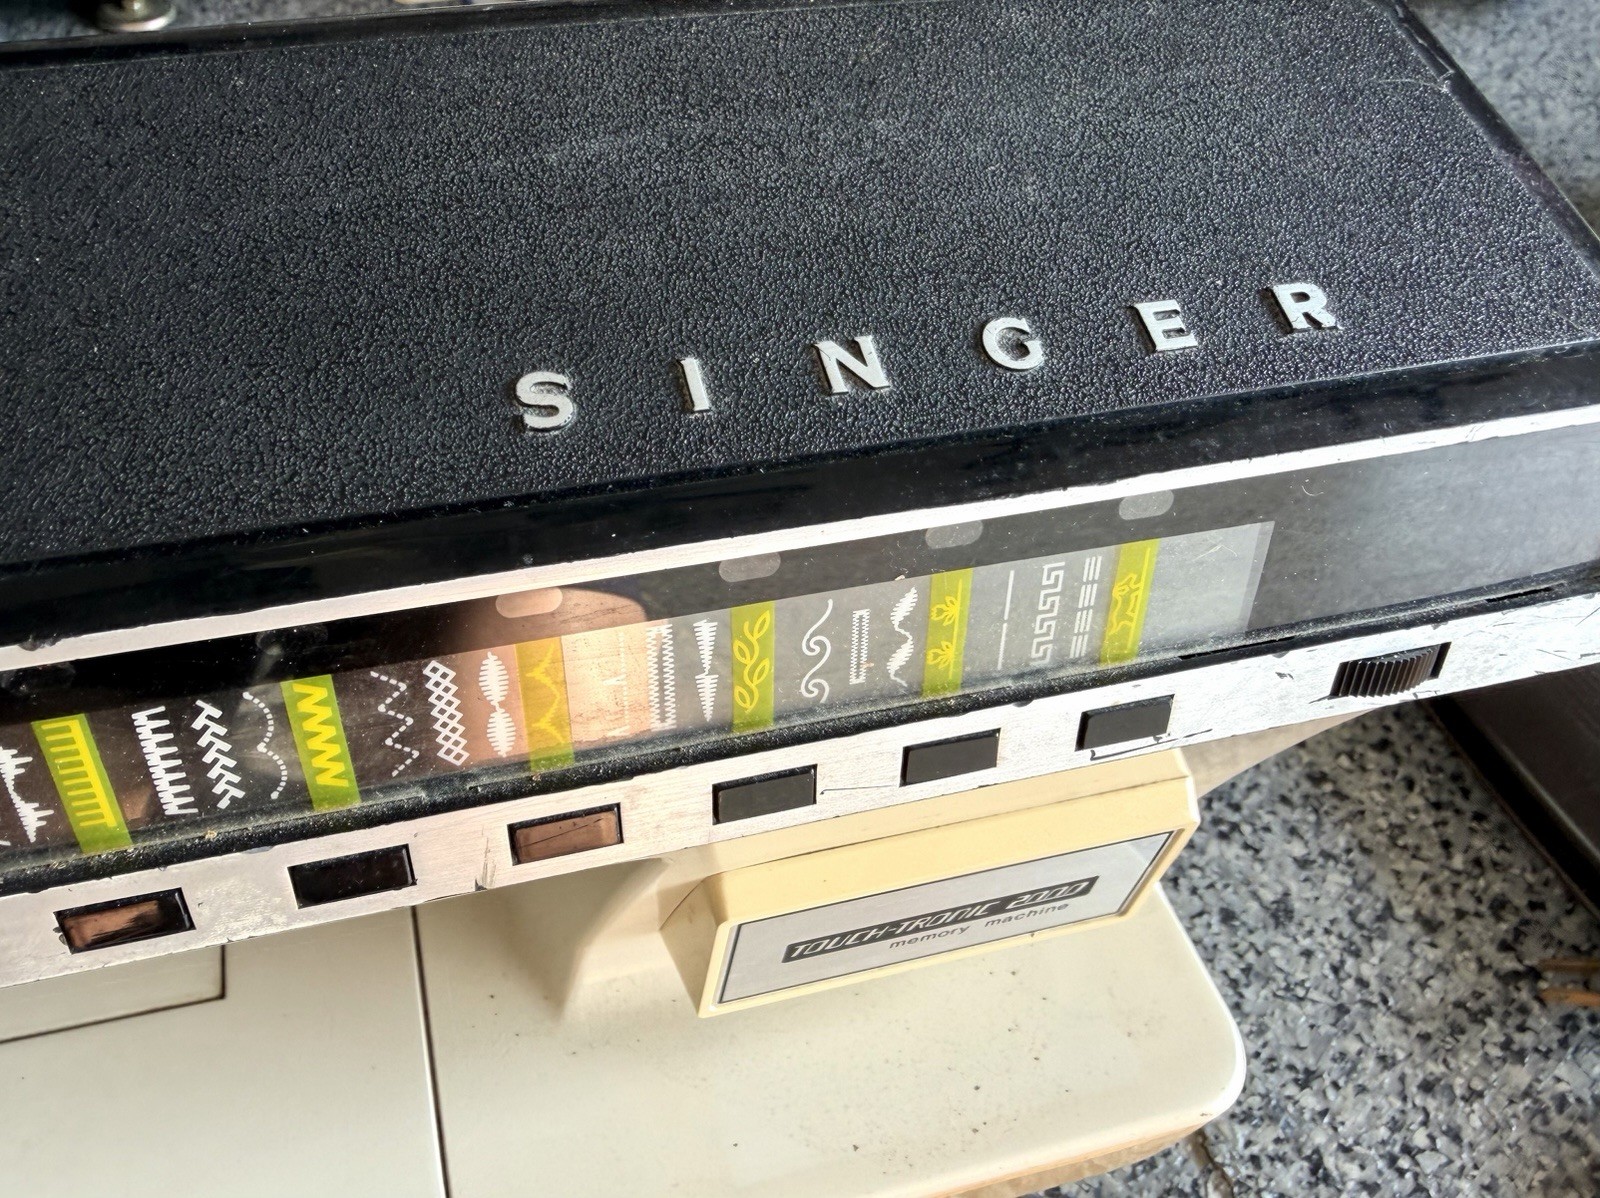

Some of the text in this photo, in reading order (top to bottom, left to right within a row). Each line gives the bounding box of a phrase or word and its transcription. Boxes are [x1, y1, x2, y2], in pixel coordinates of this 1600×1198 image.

[514, 282, 1341, 431] SINGER
[790, 881, 1088, 957] TOUCH-TRONIC 2000
[889, 902, 1069, 949] memory machine
